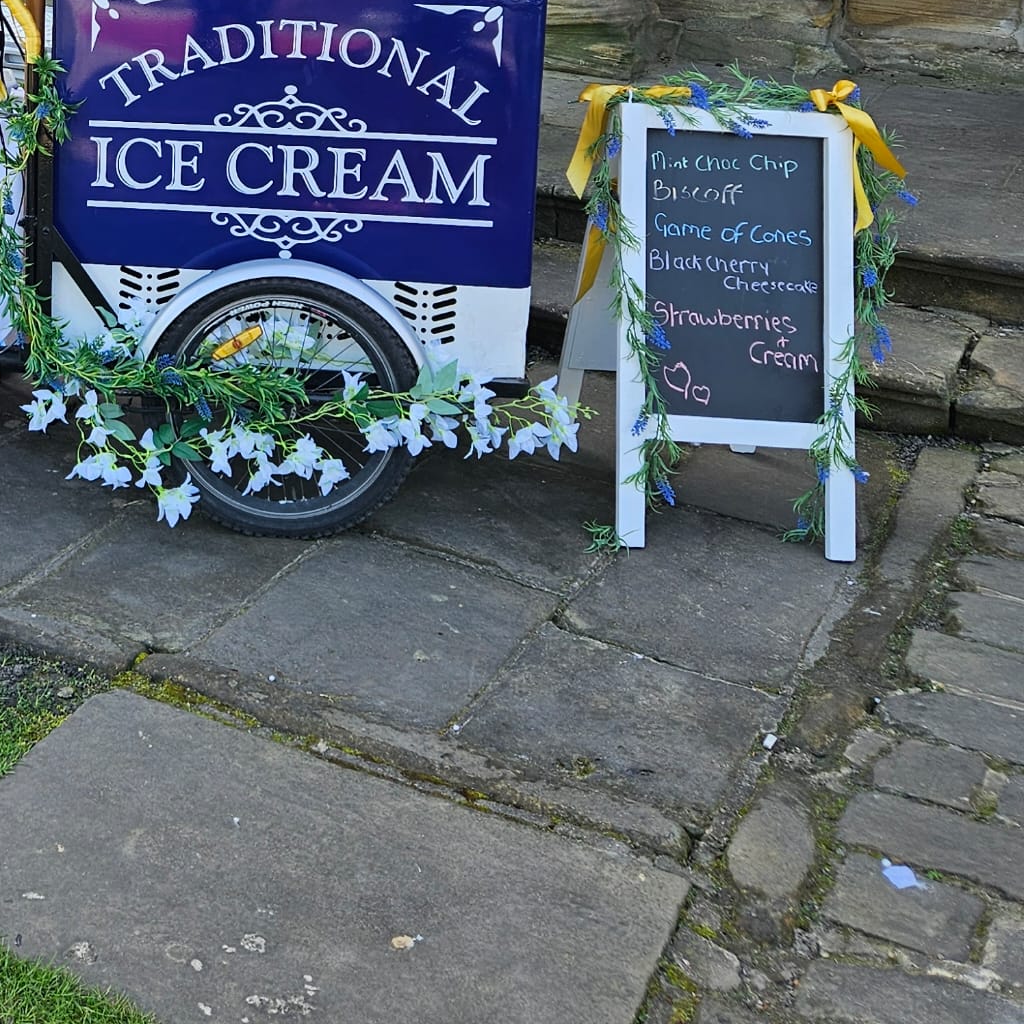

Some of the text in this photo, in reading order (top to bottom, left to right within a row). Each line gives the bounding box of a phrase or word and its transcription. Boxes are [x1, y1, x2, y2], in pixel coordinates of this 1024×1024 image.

[98, 18, 491, 126] TRADITIONAL
[90, 135, 492, 207] ICE CREAM
[651, 150, 799, 179] Mint Choc Chip
[654, 212, 813, 247] Game of Cones
[649, 248, 702, 271] Black
[723, 276, 818, 294] Cheesecake
[654, 300, 798, 334] Strawberries
[749, 341, 819, 373] Cream
